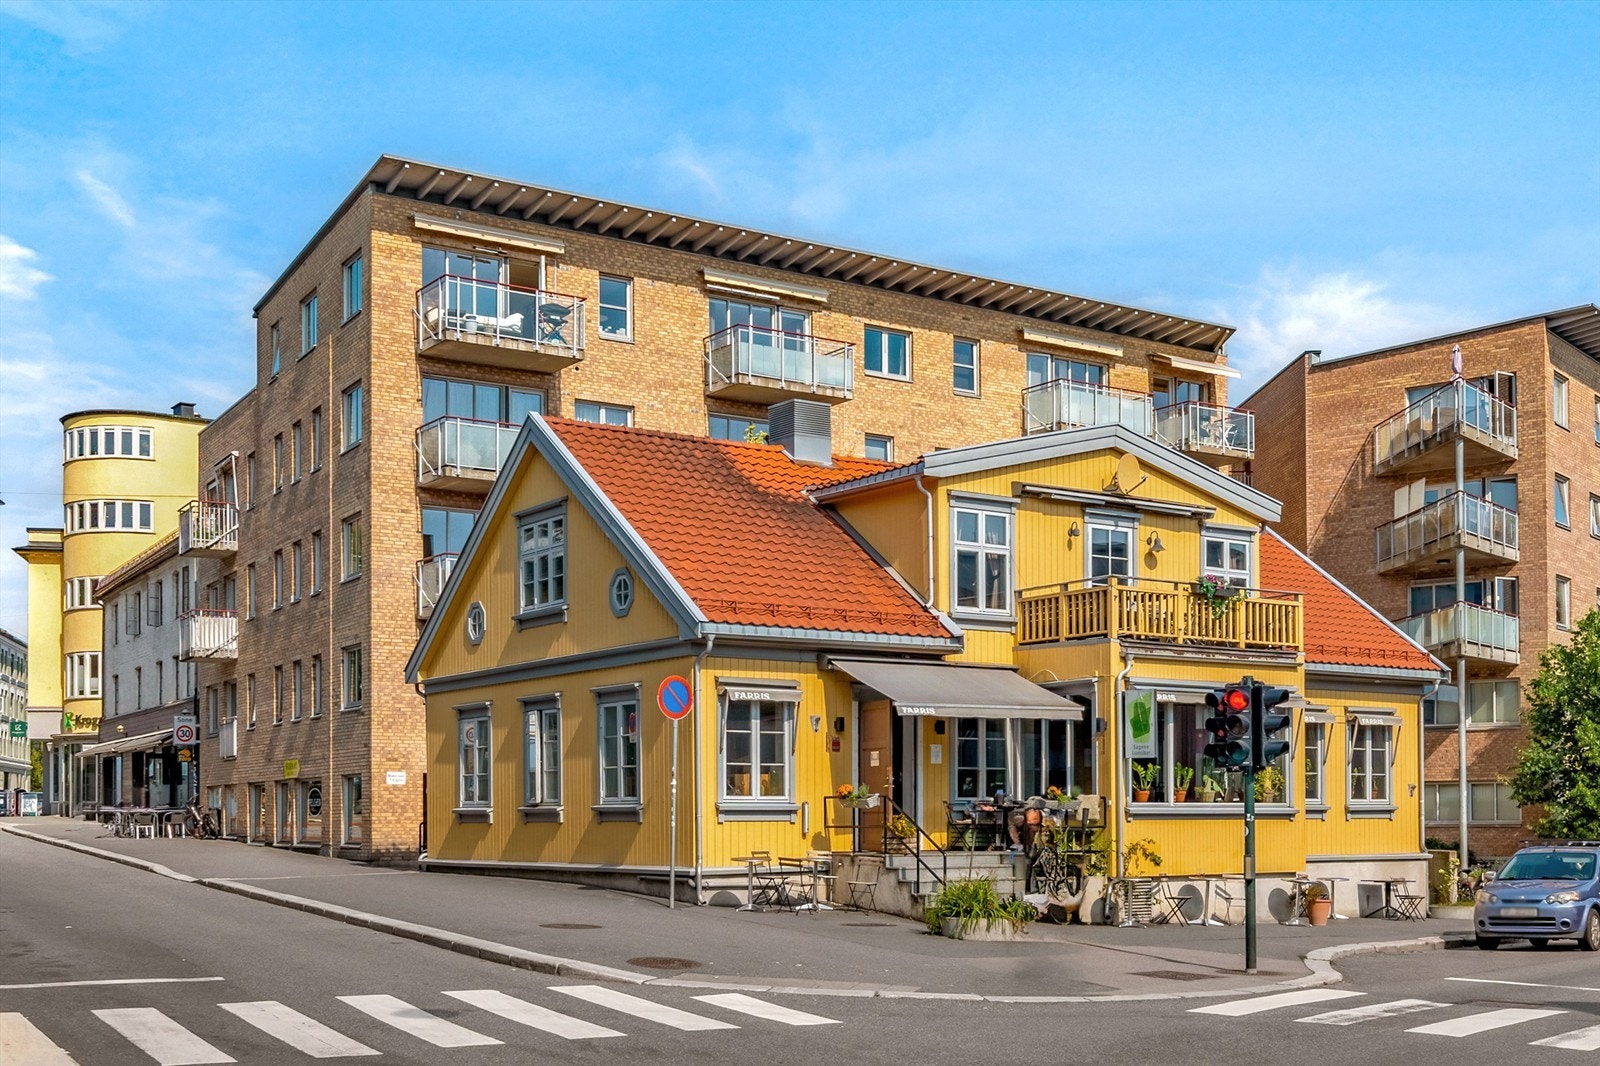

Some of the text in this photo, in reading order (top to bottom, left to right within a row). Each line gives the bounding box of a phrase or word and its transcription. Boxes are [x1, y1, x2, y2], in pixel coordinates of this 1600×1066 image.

[734, 691, 770, 700] FARRIS
[1156, 693, 1176, 701] RRIS
[901, 706, 936, 715] FARRIS
[179, 729, 191, 738] 30
